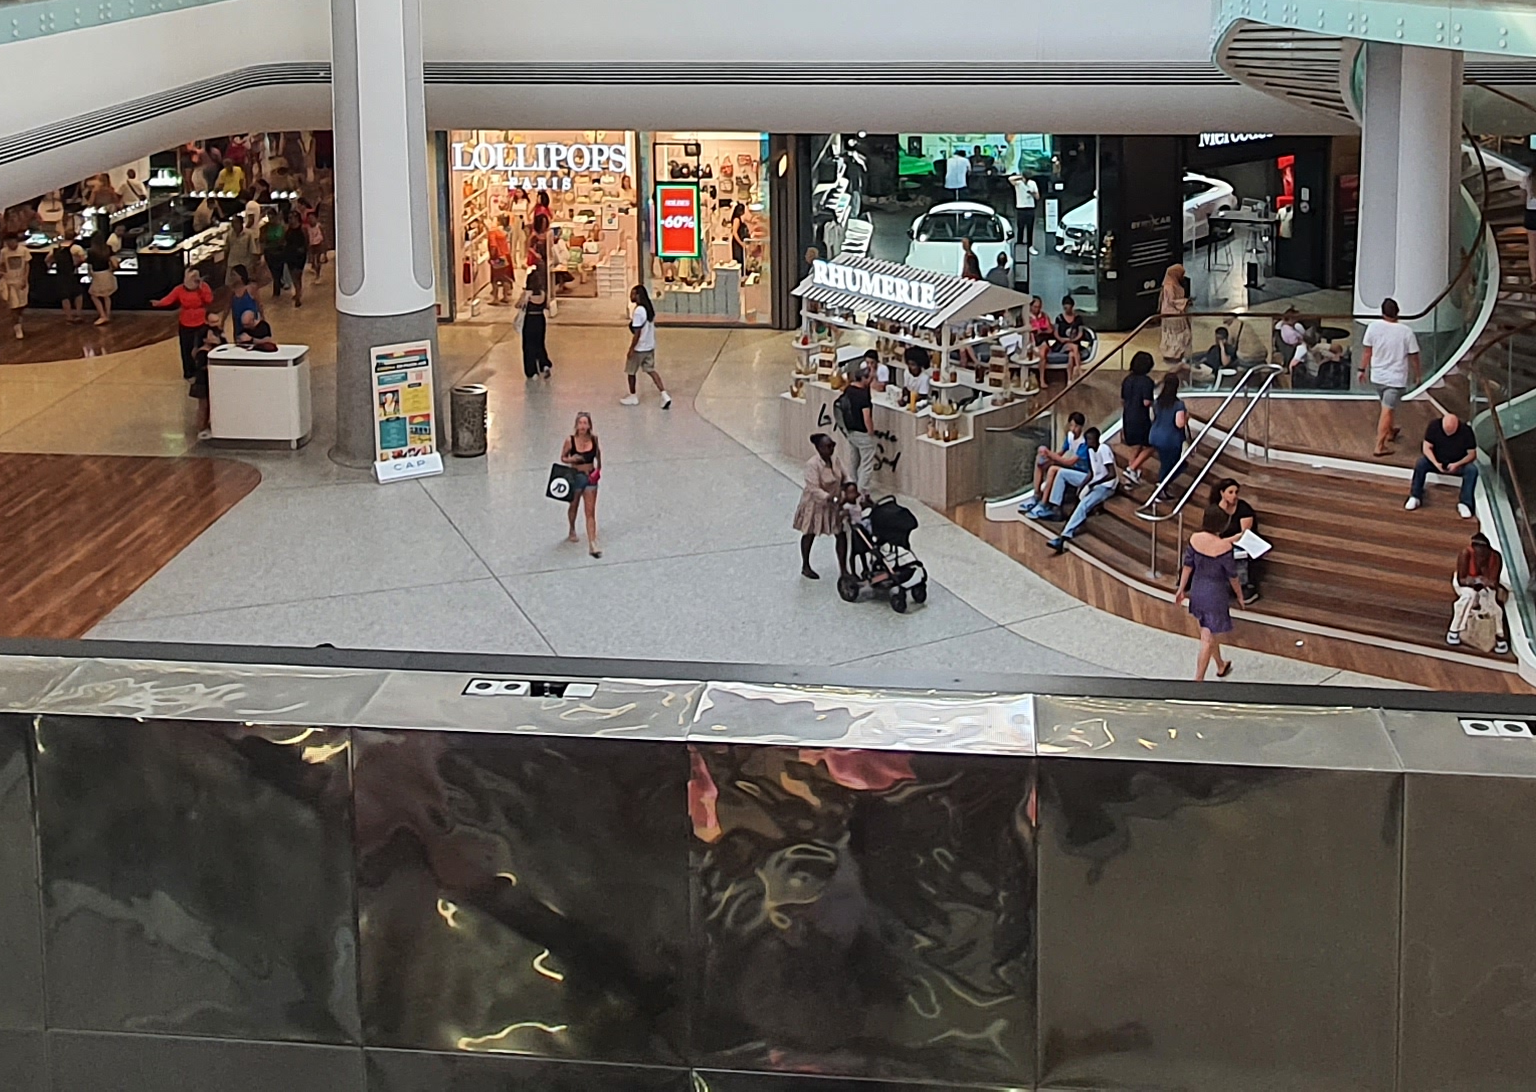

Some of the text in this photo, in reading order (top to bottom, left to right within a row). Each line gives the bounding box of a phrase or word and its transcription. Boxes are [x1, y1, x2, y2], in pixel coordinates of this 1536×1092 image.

[451, 143, 627, 172] LOLLIPOPS
[509, 176, 573, 191] PARIS
[661, 215, 695, 229] -60%
[812, 258, 937, 310] RHUMERIE
[393, 458, 426, 471] CAP
